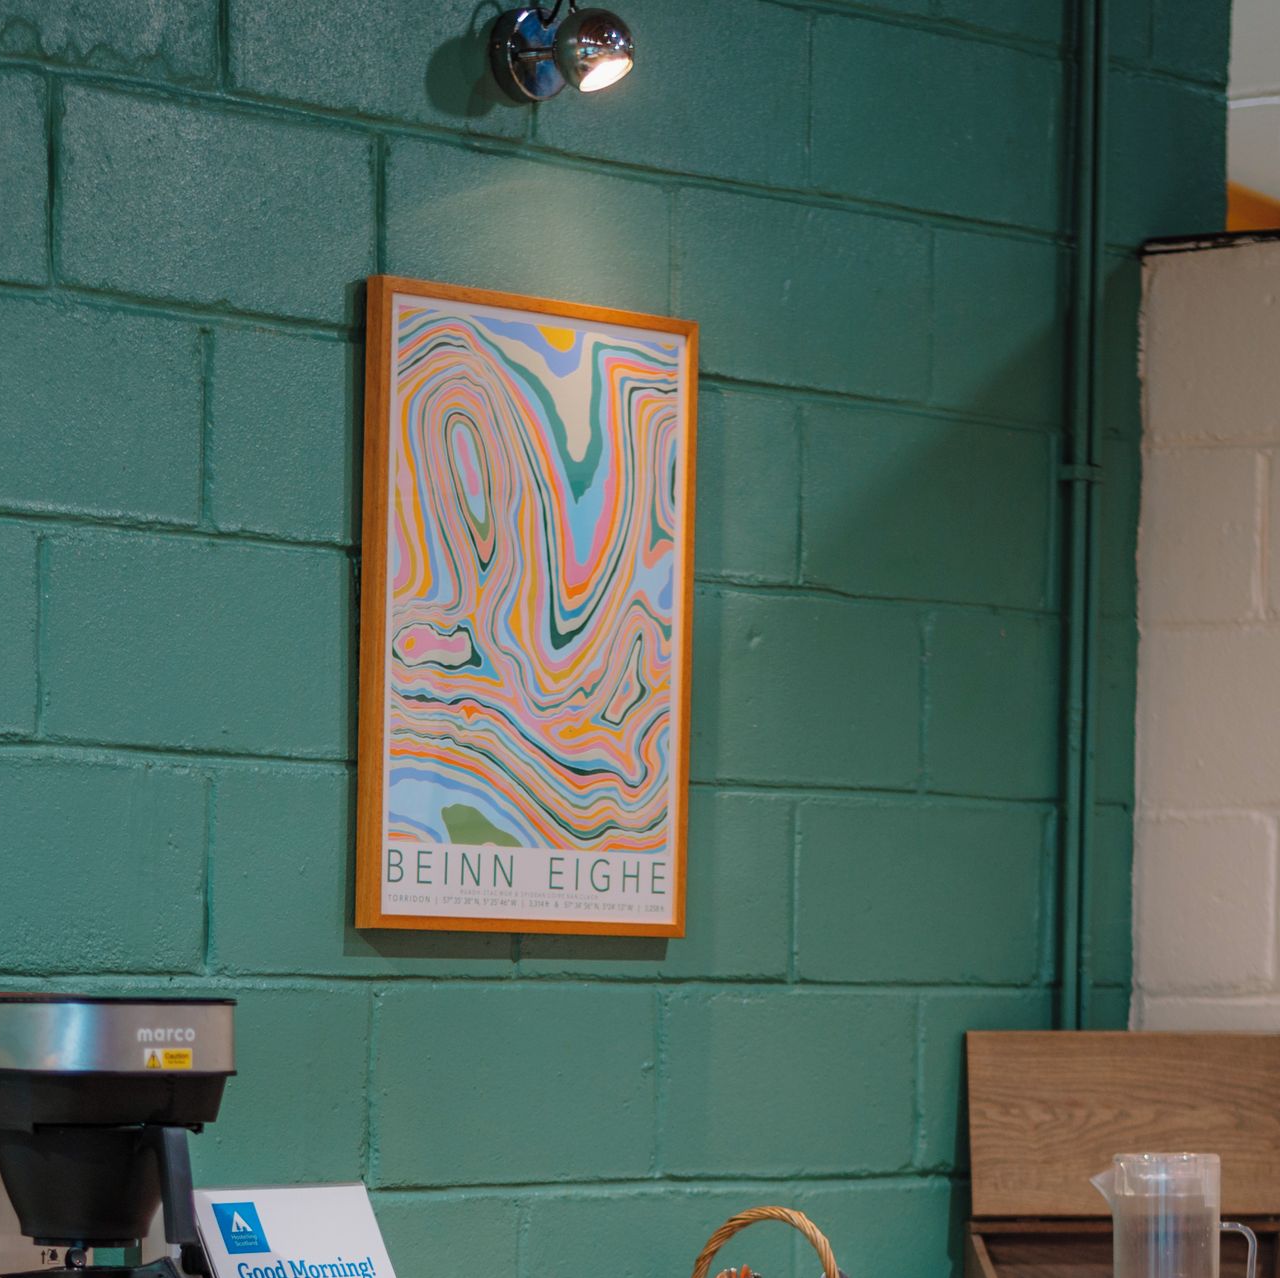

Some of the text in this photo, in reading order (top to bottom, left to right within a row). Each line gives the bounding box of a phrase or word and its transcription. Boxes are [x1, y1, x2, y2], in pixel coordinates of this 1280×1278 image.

[387, 848, 666, 894] BEINN EIGHE
[388, 894, 431, 903] TORRIDON
[137, 1028, 196, 1042] marco
